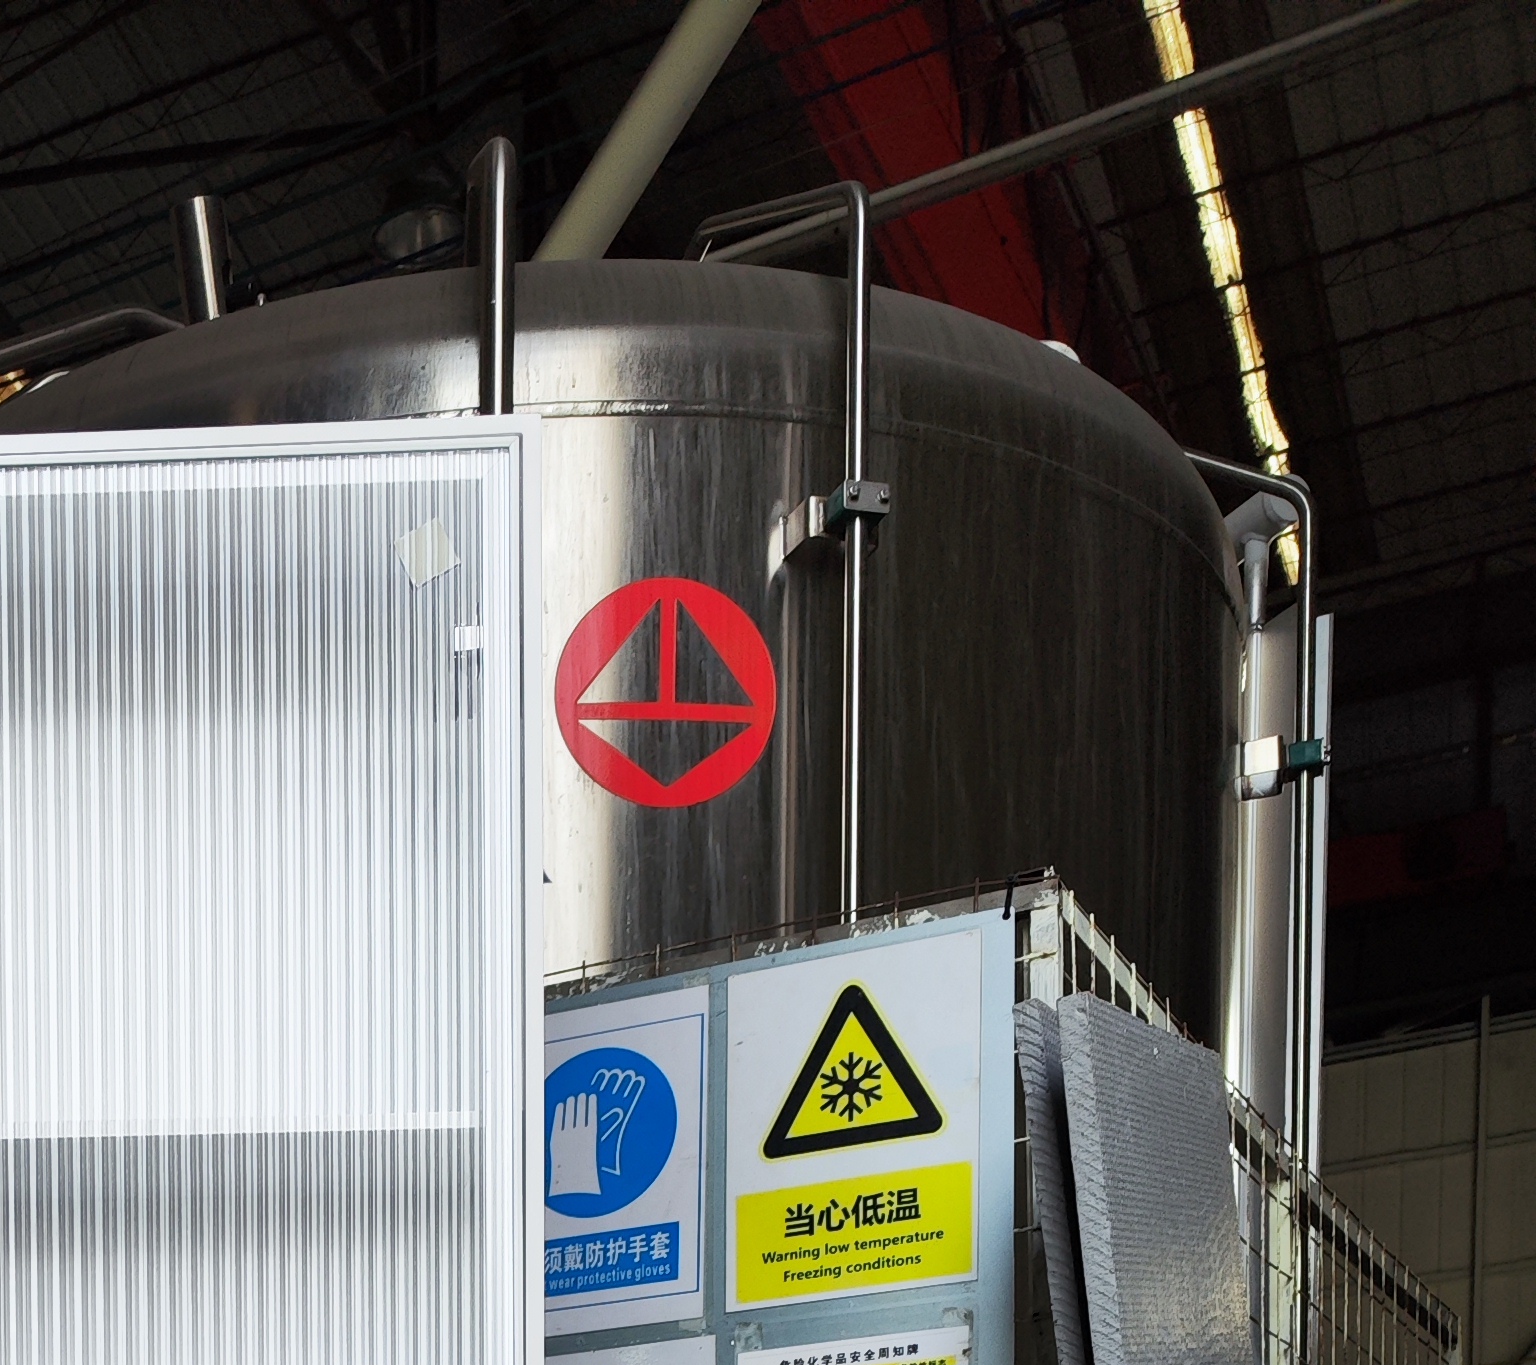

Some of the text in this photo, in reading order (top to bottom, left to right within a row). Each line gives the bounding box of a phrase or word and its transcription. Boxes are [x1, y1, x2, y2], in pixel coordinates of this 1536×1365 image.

[784, 1187, 921, 1238] 当心低温
[762, 1230, 944, 1264] Warning low temperature
[549, 1263, 670, 1290] wear protective gloves
[783, 1254, 922, 1282] Freezing conditions
